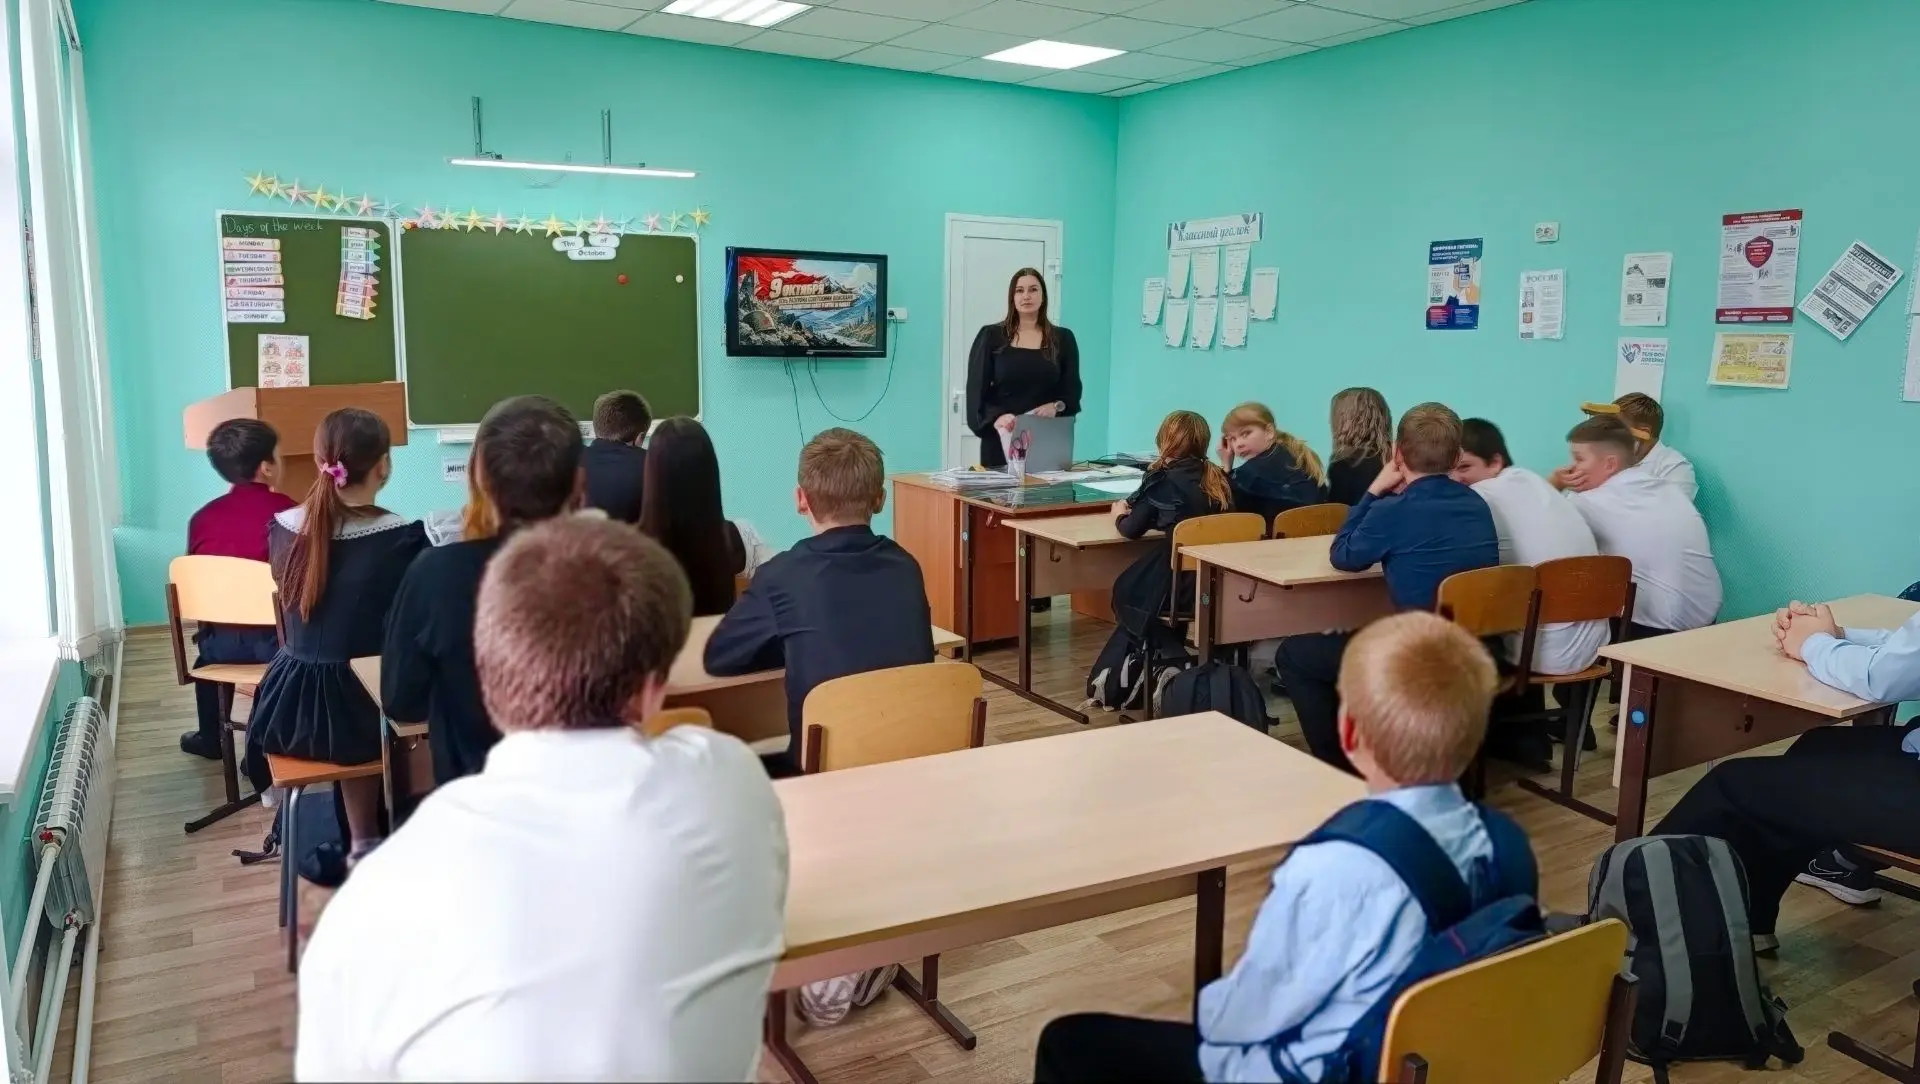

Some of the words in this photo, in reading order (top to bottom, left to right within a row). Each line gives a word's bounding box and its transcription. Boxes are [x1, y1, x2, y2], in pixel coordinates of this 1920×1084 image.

[225, 217, 255, 236] Days
[260, 223, 270, 235] of
[273, 218, 289, 231] the
[1177, 226, 1218, 242] Классный
[1219, 226, 1250, 241] уголок
[769, 278, 783, 299] 9
